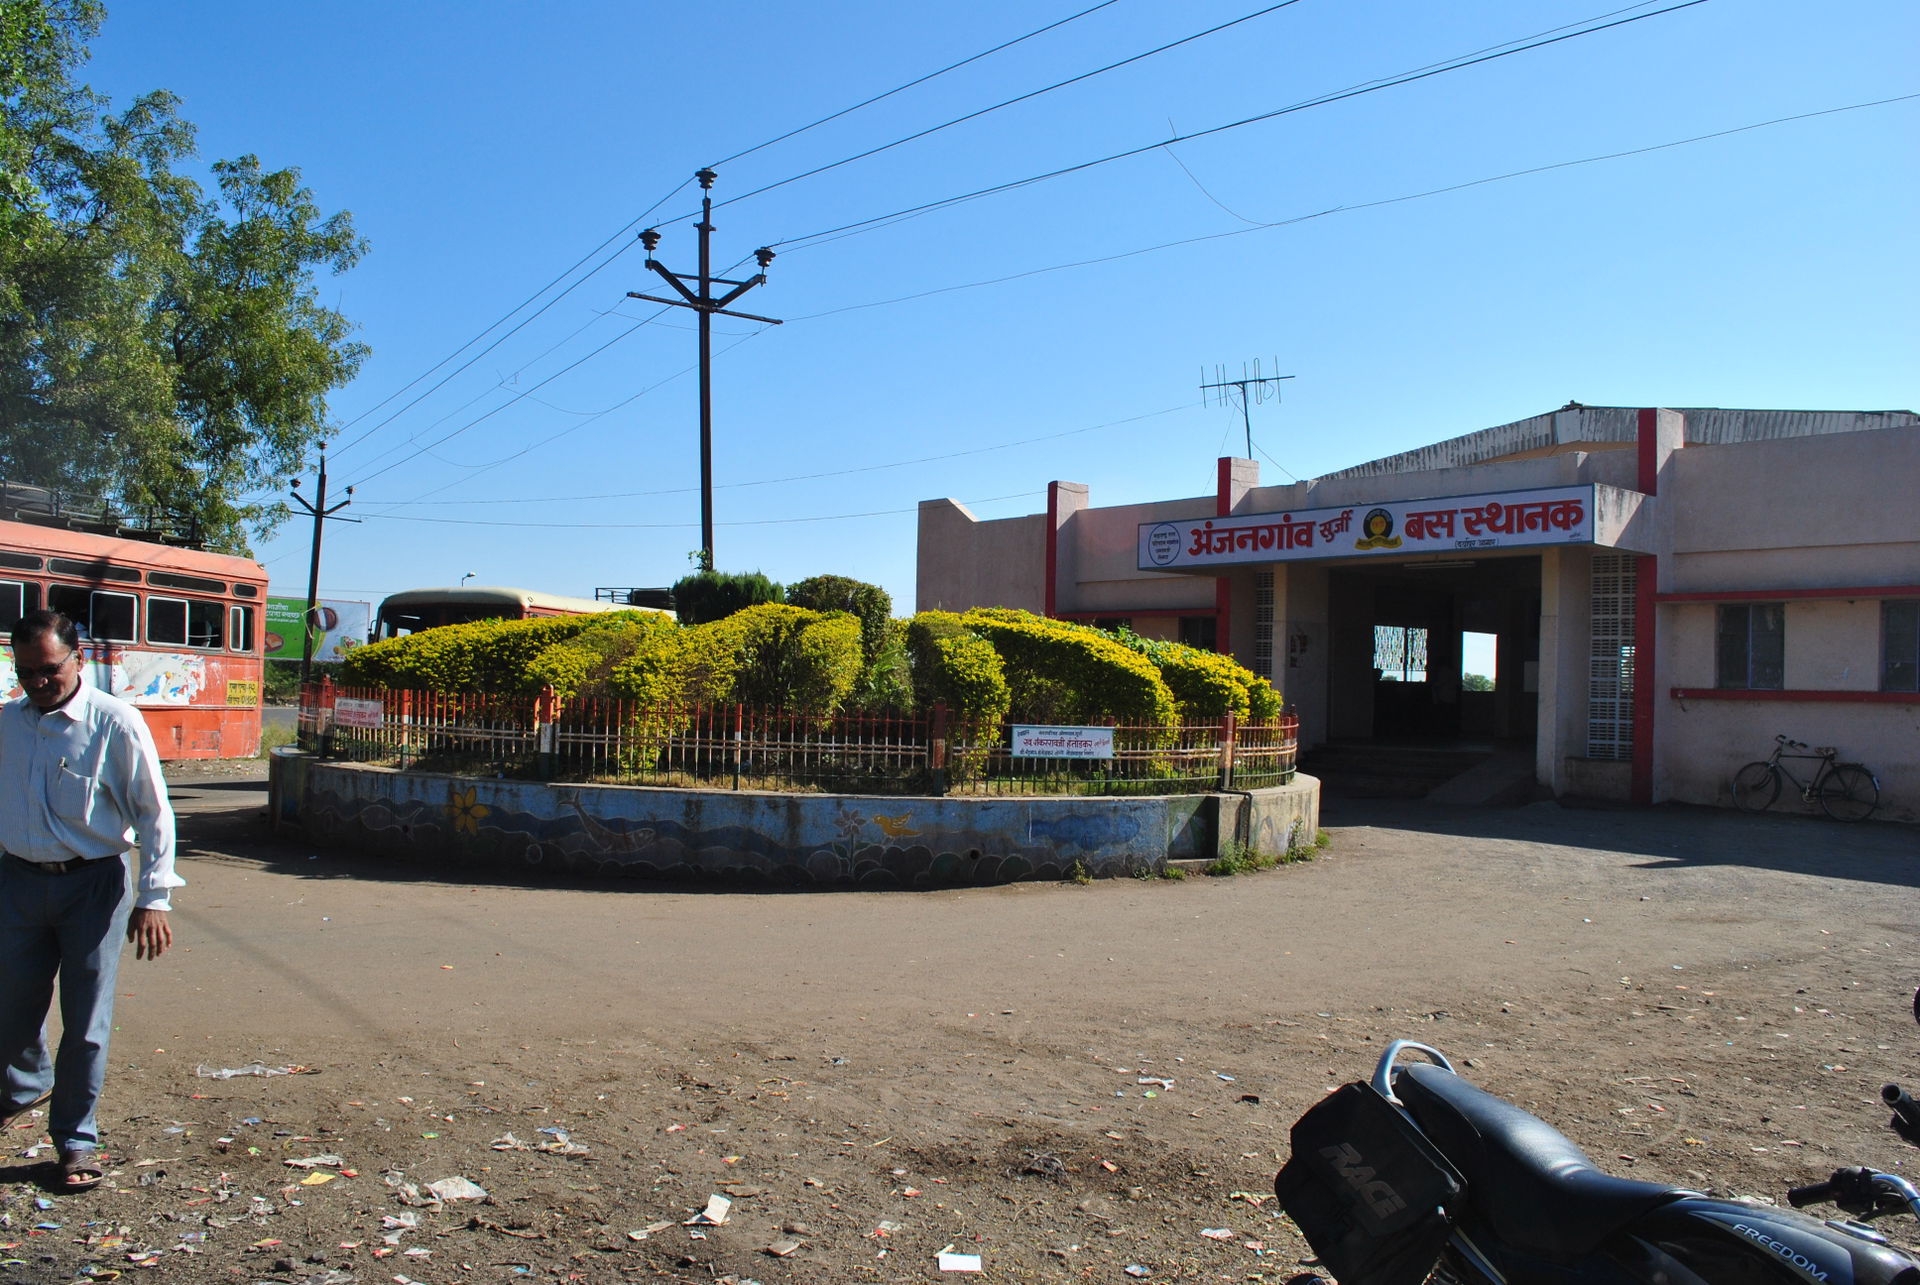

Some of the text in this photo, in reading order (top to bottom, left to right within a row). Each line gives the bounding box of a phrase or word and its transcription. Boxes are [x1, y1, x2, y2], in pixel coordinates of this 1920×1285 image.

[1187, 498, 1585, 556] अंजनगांव सुर्जी बस स्थानक
[1318, 1142, 1407, 1219] RACE
[1732, 1223, 1828, 1282] FREEDOM
